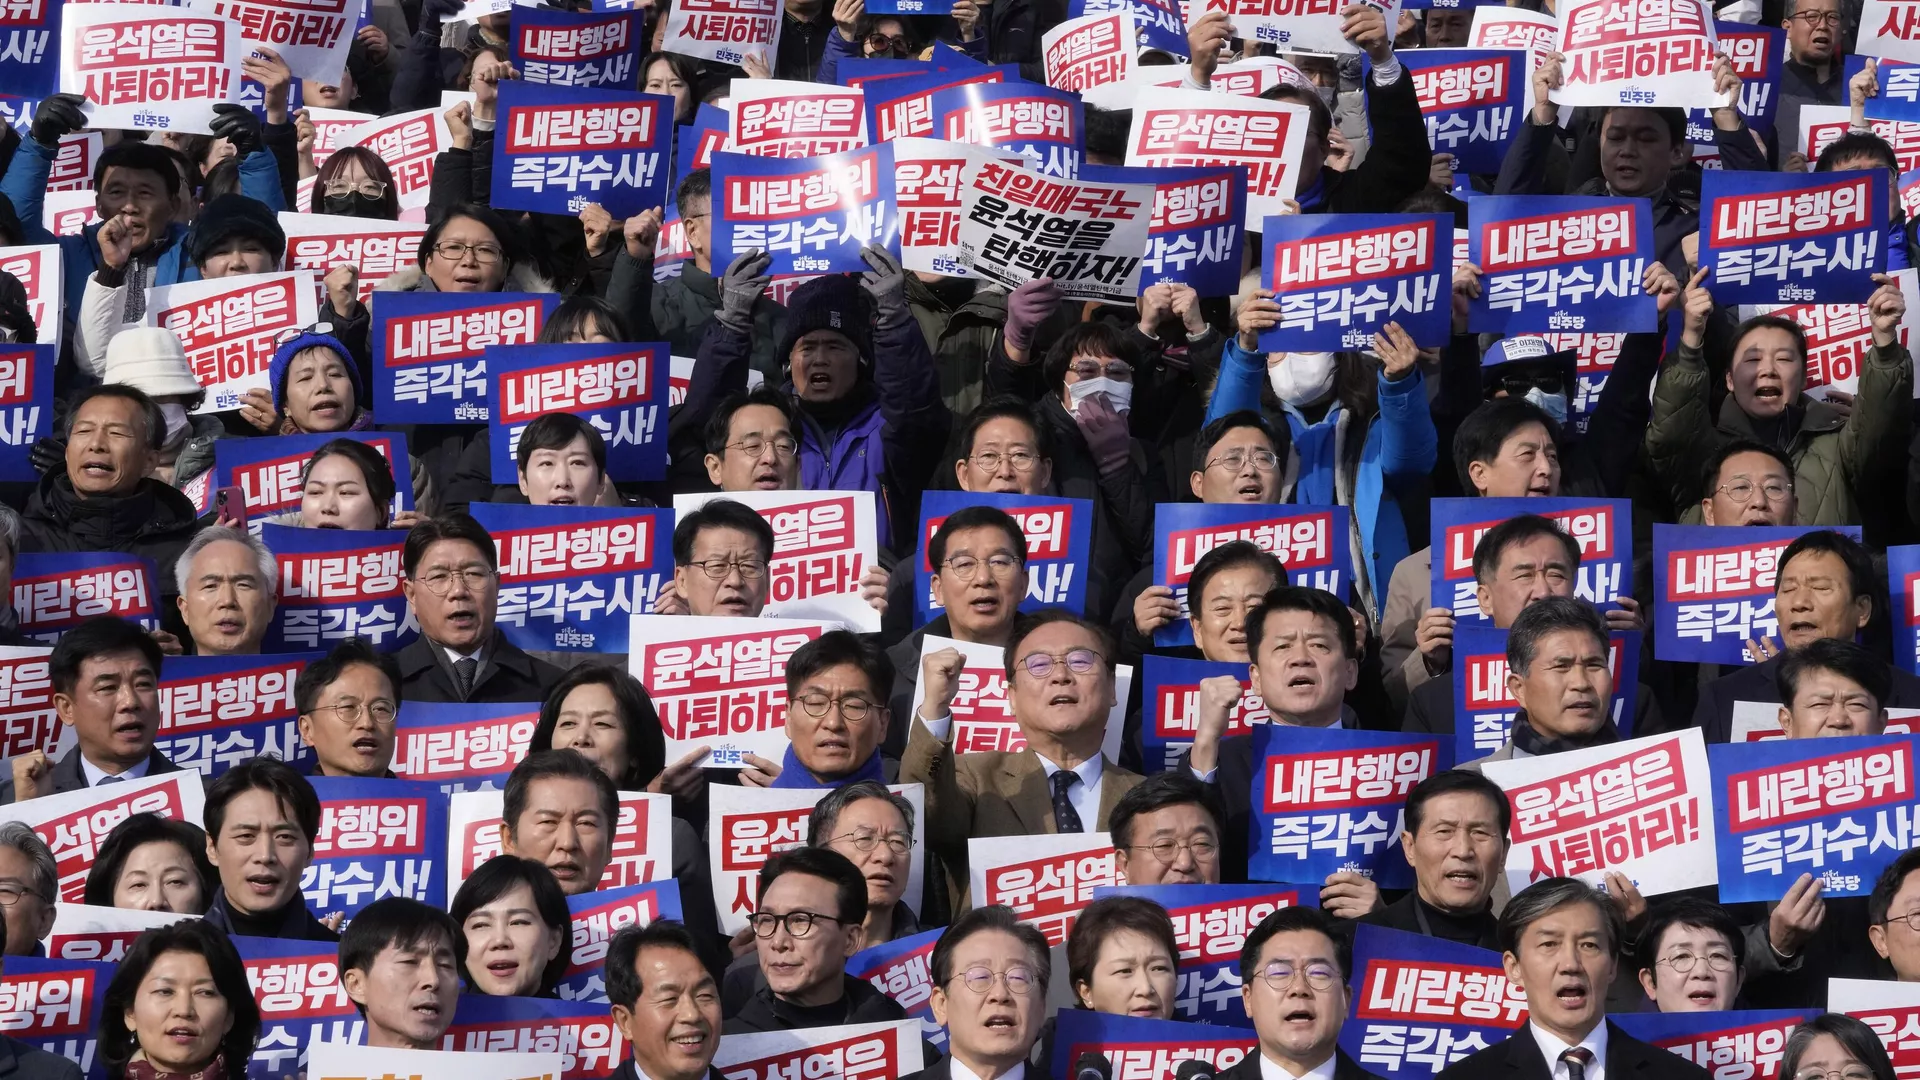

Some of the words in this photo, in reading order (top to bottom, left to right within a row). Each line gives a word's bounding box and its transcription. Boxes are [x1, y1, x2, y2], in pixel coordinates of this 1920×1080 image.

[679, 15, 777, 47] 사퇴하라!
[897, 1, 924, 11] 민주당
[1571, 0, 1700, 49] 윤석열은
[82, 23, 217, 64] 윤석열은
[523, 20, 627, 60] 내란행위
[716, 50, 743, 63] 민주당
[1047, 21, 1118, 86] 윤석열은
[1256, 26, 1292, 42] 민주당
[83, 67, 231, 106] 사퇴하라!
[523, 54, 632, 88] 즉각수사!
[1566, 38, 1713, 85] 사퇴하라!
[133, 114, 170, 128] 민주당
[741, 98, 856, 139] 윤석열은
[1620, 91, 1656, 103] 민주당
[515, 106, 652, 147] 내란행위
[1146, 111, 1282, 151] 윤석열은
[511, 153, 660, 193] 즉각수사!
[732, 160, 872, 222] 내란행위
[895, 164, 963, 201] 윤석
[973, 162, 1142, 220] 친일매국노
[732, 201, 884, 255] 즉각수사!
[968, 194, 1116, 250] 윤석열을
[1718, 180, 1867, 240] 내란행위
[980, 232, 1141, 286] 탄핵하자!
[1280, 227, 1428, 284] 내란행위
[1490, 210, 1630, 266] 내란행위
[1716, 229, 1879, 285] 즉각수사!
[793, 258, 830, 271] 민주당
[1488, 257, 1645, 312] 즉각수사!
[164, 286, 286, 346] 윤석열은
[1280, 274, 1440, 332] 즉각수사!
[1778, 288, 1817, 301] 민주당
[394, 306, 536, 361] 내란행위
[1548, 314, 1586, 330] 민주당
[506, 356, 648, 416] 내란행위
[498, 522, 648, 577] 내란행위
[769, 504, 846, 551] 열은
[283, 549, 402, 599] 내란행
[496, 573, 661, 627] 즉각수사!
[555, 632, 596, 648] 민주당
[1271, 749, 1431, 805] 내란행위
[1514, 748, 1674, 834] 윤석열은
[1737, 749, 1906, 824] 내란행위
[1528, 797, 1700, 884] 사퇴하라!
[996, 856, 1128, 914] 윤석열
